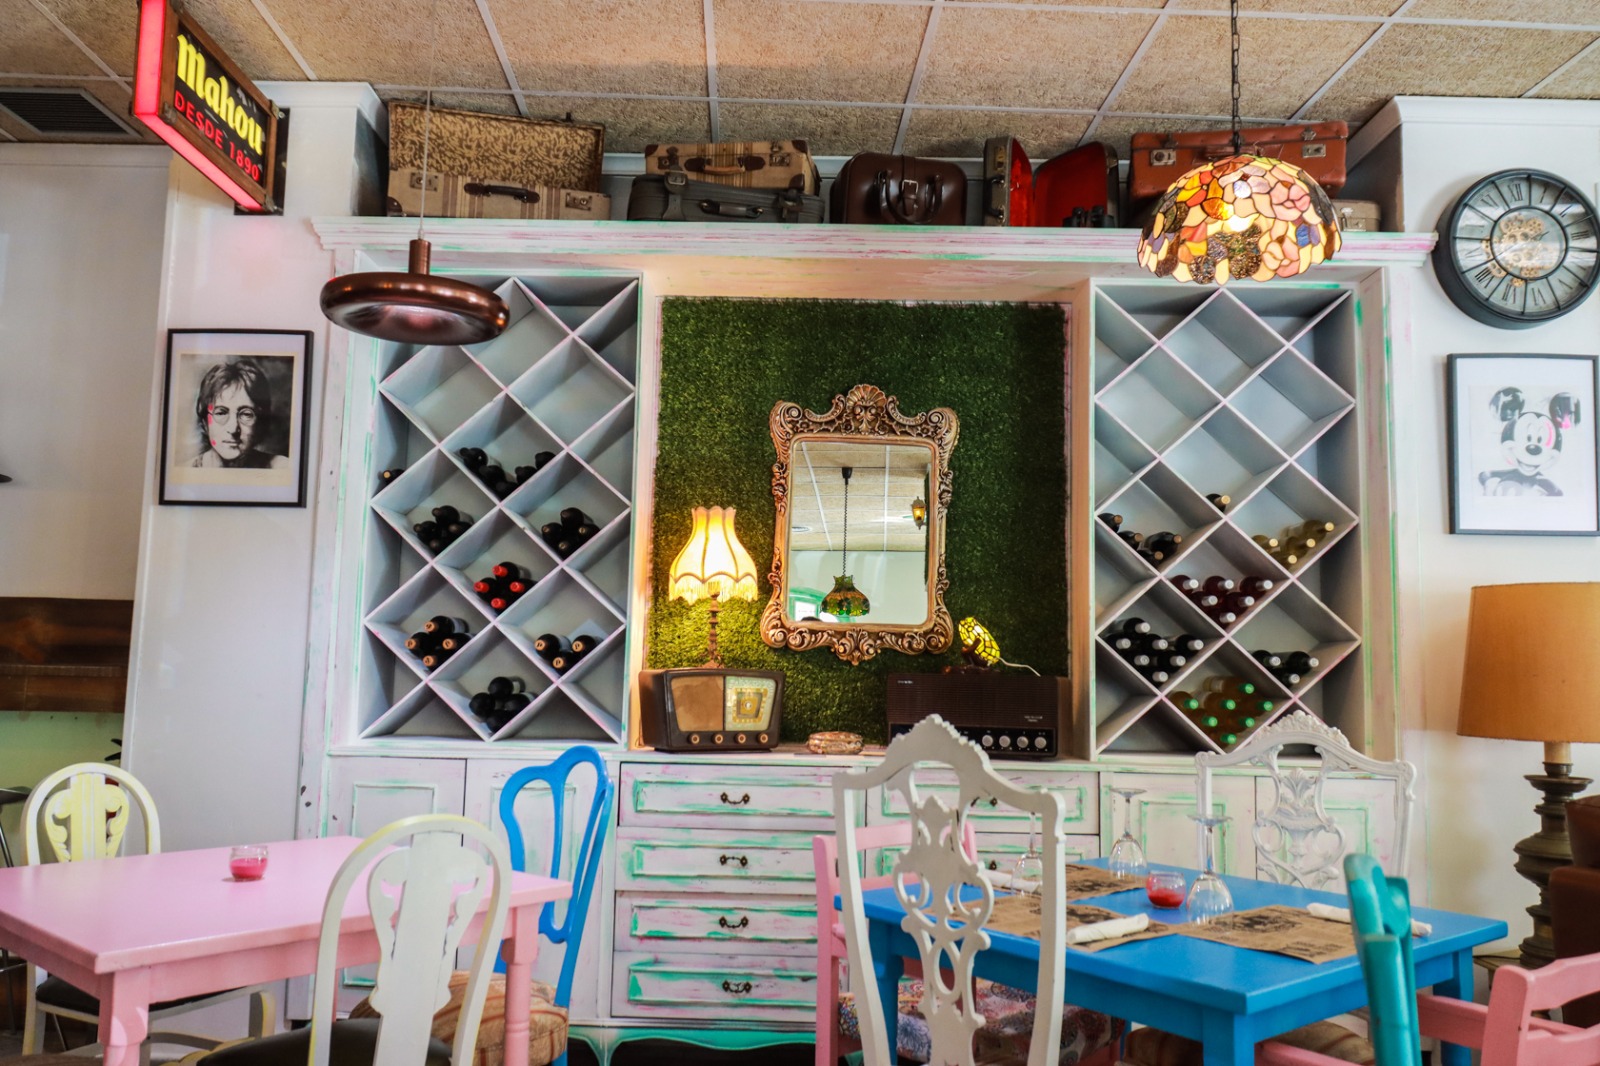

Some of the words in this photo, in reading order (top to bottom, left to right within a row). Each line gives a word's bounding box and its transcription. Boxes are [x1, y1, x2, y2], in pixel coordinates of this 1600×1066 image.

[174, 90, 224, 150] DESDE
[229, 142, 260, 182] 1890
[177, 34, 263, 156] Mahou
[1507, 183, 1523, 202] XII
